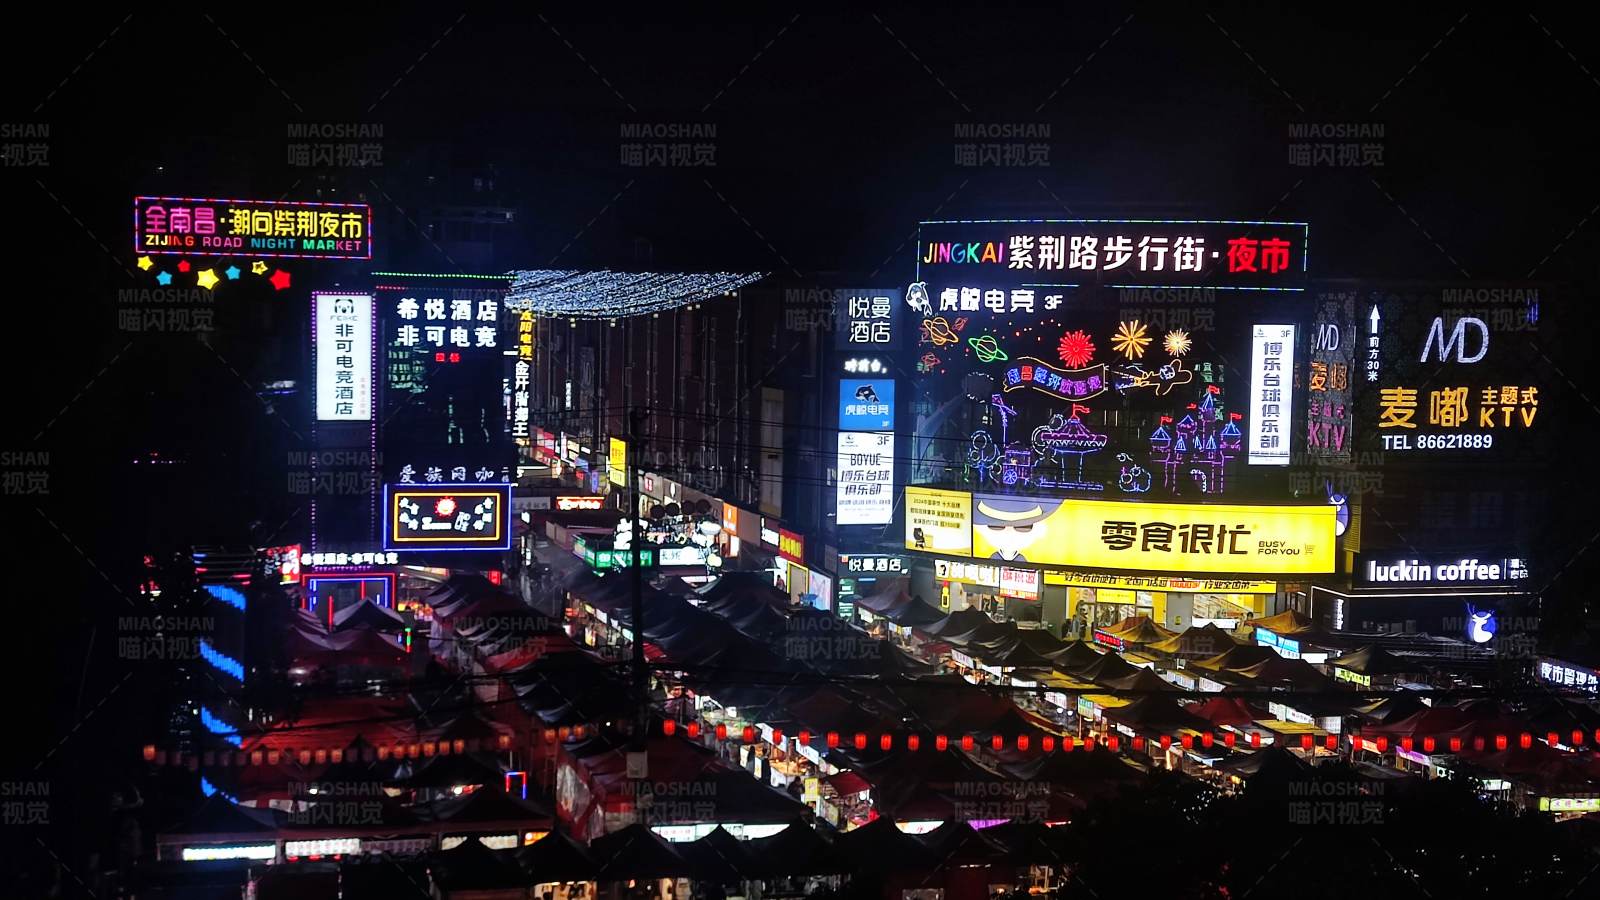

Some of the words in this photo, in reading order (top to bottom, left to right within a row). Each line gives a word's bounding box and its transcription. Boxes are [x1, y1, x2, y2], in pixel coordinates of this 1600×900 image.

[145, 205, 363, 239] 全南昌·潮向紫荆夜市
[202, 236, 243, 248] ROAD
[251, 238, 296, 249] NIGHT
[303, 239, 362, 251] MARKET
[923, 241, 1004, 266] JINGKAI
[397, 298, 499, 321] 希悦酒店
[848, 296, 891, 318] 悦曼
[938, 287, 1035, 313] 虎鲸电竞
[1044, 294, 1063, 310] 3F
[397, 325, 497, 348] 非可电竞
[848, 321, 891, 343] 酒店
[1280, 329, 1291, 338] 3F
[335, 323, 354, 416] 非可电竞酒店
[1367, 336, 1380, 382] 前方30米
[1260, 341, 1283, 449] 博乐台球俱乐部
[845, 404, 889, 416] 虎鲸电竞
[1378, 386, 1469, 429] 麦嘟
[1480, 385, 1539, 406] 主题式
[1479, 407, 1538, 428] KTV
[877, 435, 890, 446] 3F
[1308, 421, 1346, 451] KTV
[1382, 435, 1412, 450] TEL
[1417, 434, 1493, 450] 86621889
[850, 453, 881, 466] BOYUE
[840, 470, 890, 482] 博乐台球
[845, 484, 882, 496] 俱乐部
[1101, 520, 1251, 555] 零食很忙
[1258, 540, 1286, 548] BUSY
[1257, 548, 1278, 556] FOR
[1280, 548, 1301, 556] YOU
[1370, 560, 1431, 582] luckin
[1437, 559, 1500, 581] coffee
